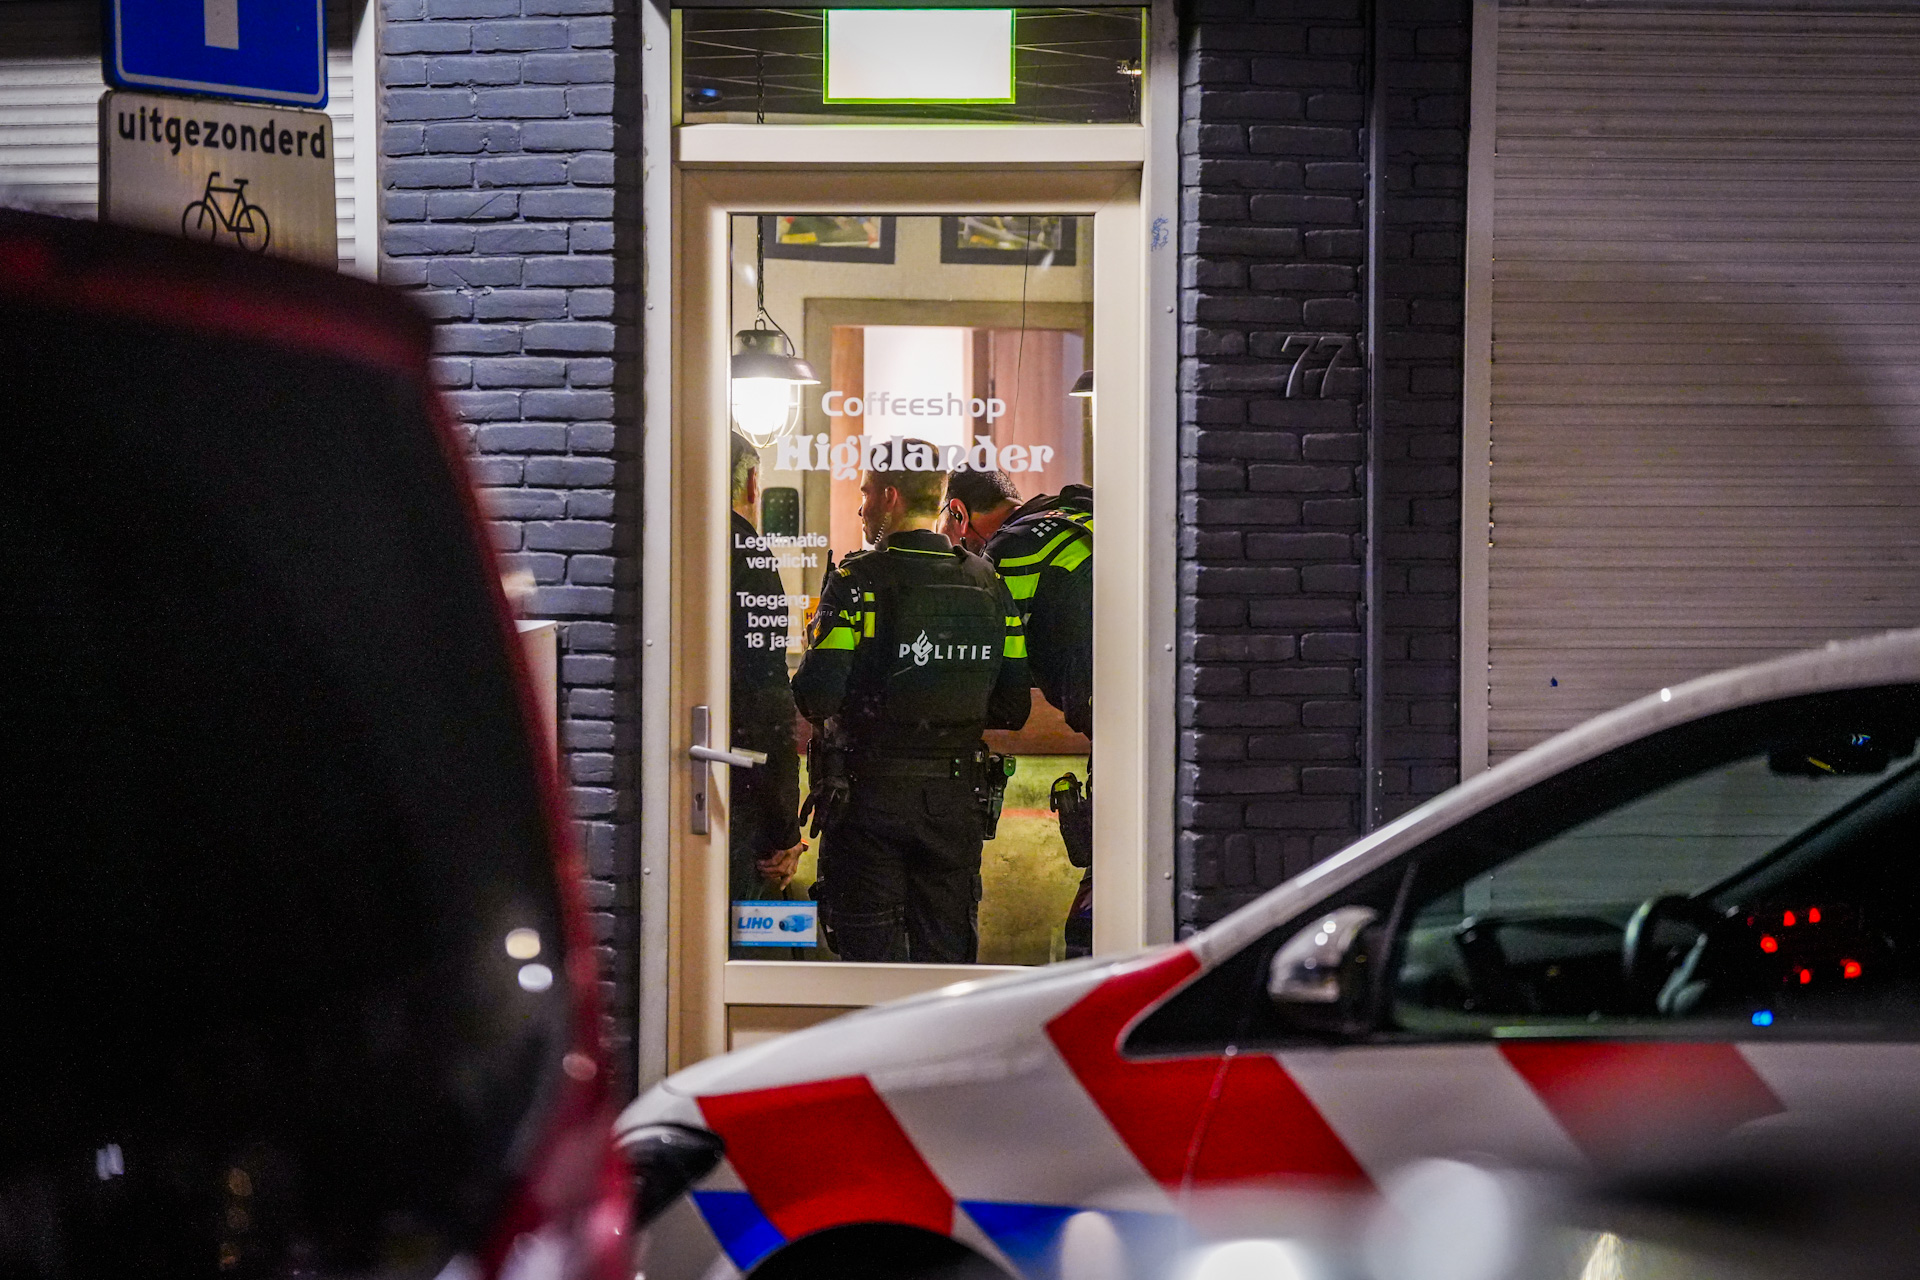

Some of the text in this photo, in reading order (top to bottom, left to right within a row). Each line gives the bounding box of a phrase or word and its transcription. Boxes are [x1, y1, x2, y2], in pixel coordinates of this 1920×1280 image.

[118, 106, 326, 159] uitgezonderd
[1281, 335, 1352, 398] 77
[821, 390, 1006, 423] Coffeeshop
[774, 432, 1054, 481] Highlander
[734, 533, 828, 551] Legitimatie
[746, 553, 818, 572] verplicht
[736, 591, 810, 609] Toegang
[747, 612, 798, 628] boven
[744, 632, 803, 651] 18 jaar
[899, 643, 992, 664] POLITIE
[738, 917, 774, 930] LIHO
